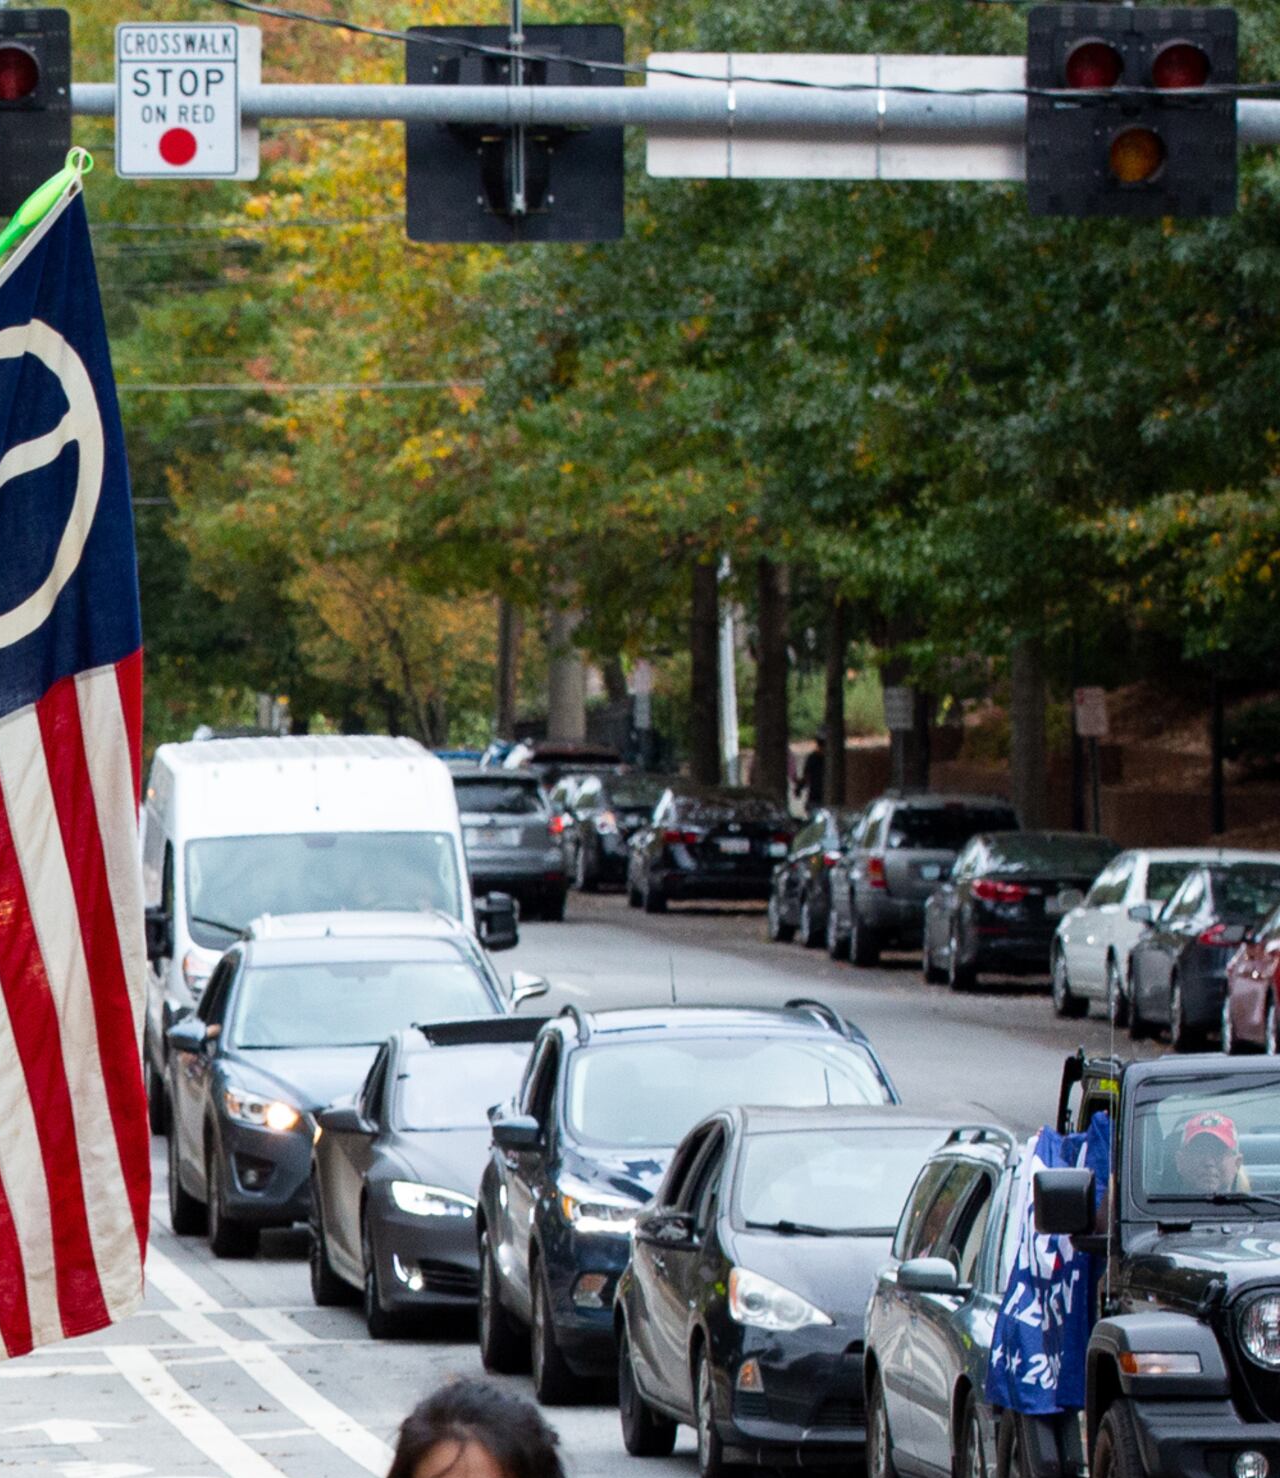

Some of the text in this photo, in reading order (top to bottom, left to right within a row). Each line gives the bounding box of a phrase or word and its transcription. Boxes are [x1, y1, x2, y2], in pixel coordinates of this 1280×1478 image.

[123, 33, 233, 55] CROSSWALK
[132, 68, 225, 97] STOP
[141, 104, 216, 124] ON RED
